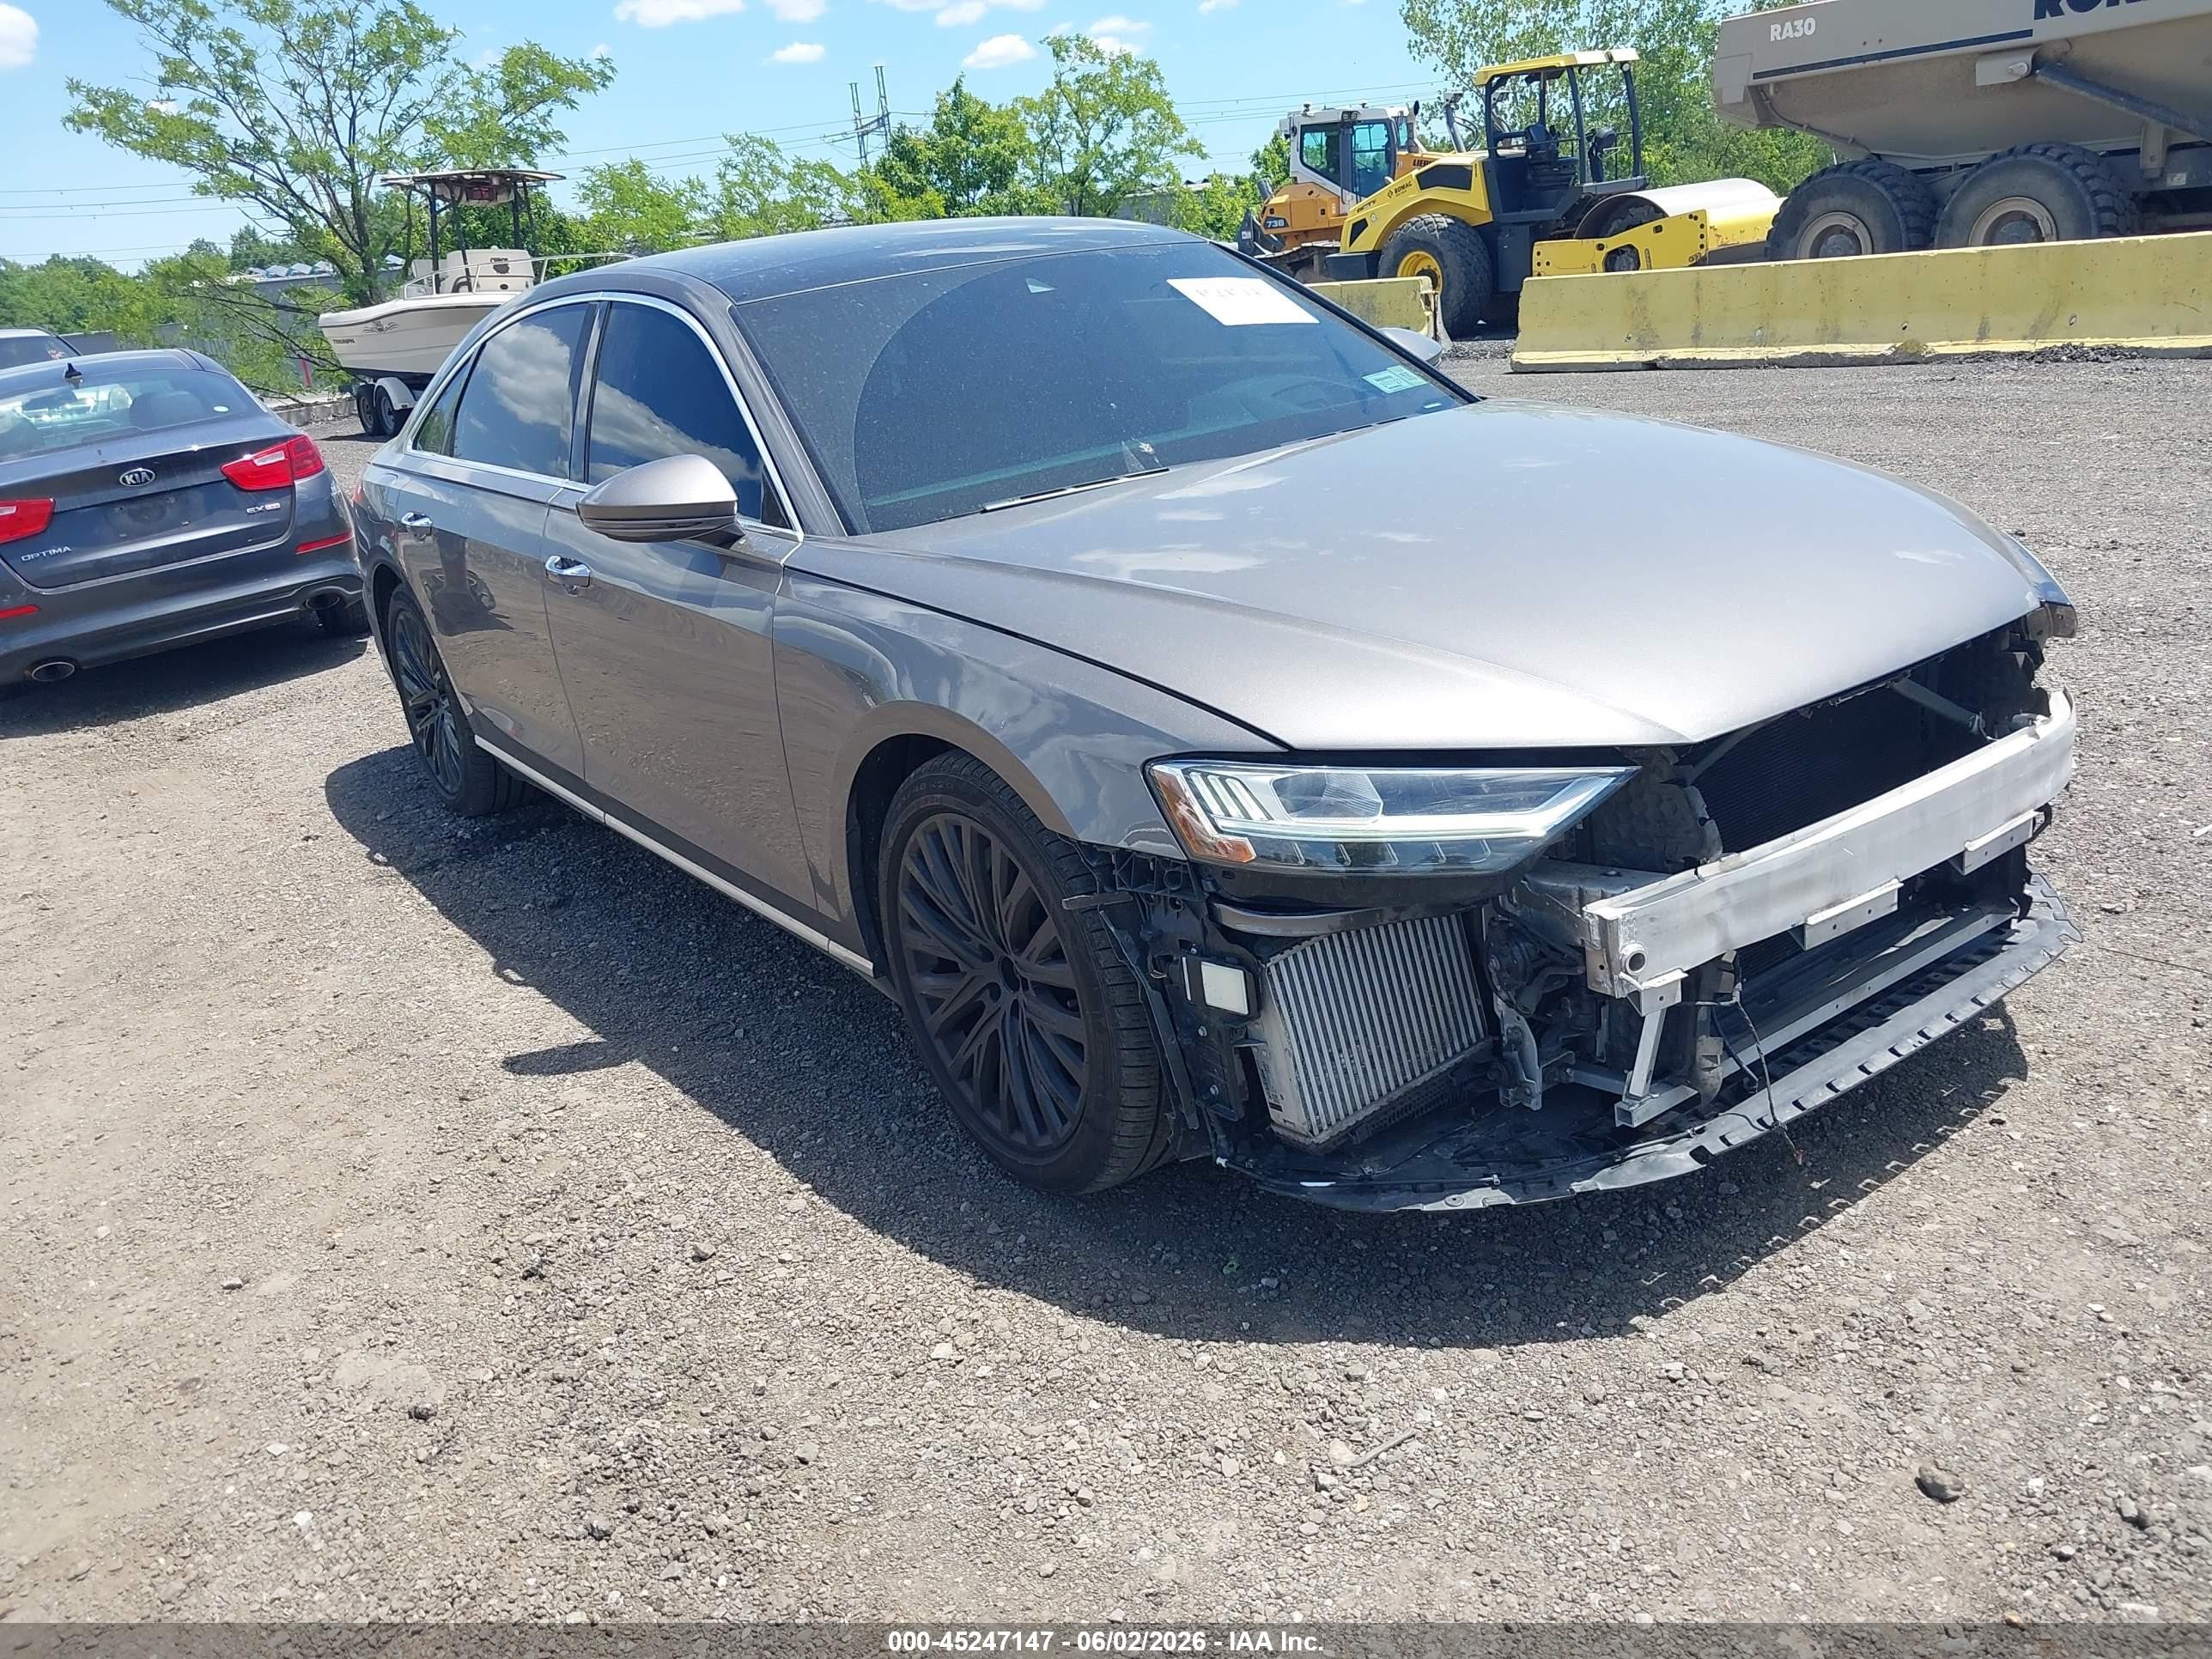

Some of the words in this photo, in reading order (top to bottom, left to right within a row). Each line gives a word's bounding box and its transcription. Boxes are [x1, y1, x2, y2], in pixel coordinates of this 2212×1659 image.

[1770, 17, 1816, 42] RA30
[1394, 180, 1413, 194] BOMAG
[124, 471, 152, 485] KIA
[246, 505, 264, 514] EX
[21, 545, 72, 562] OPTIMA
